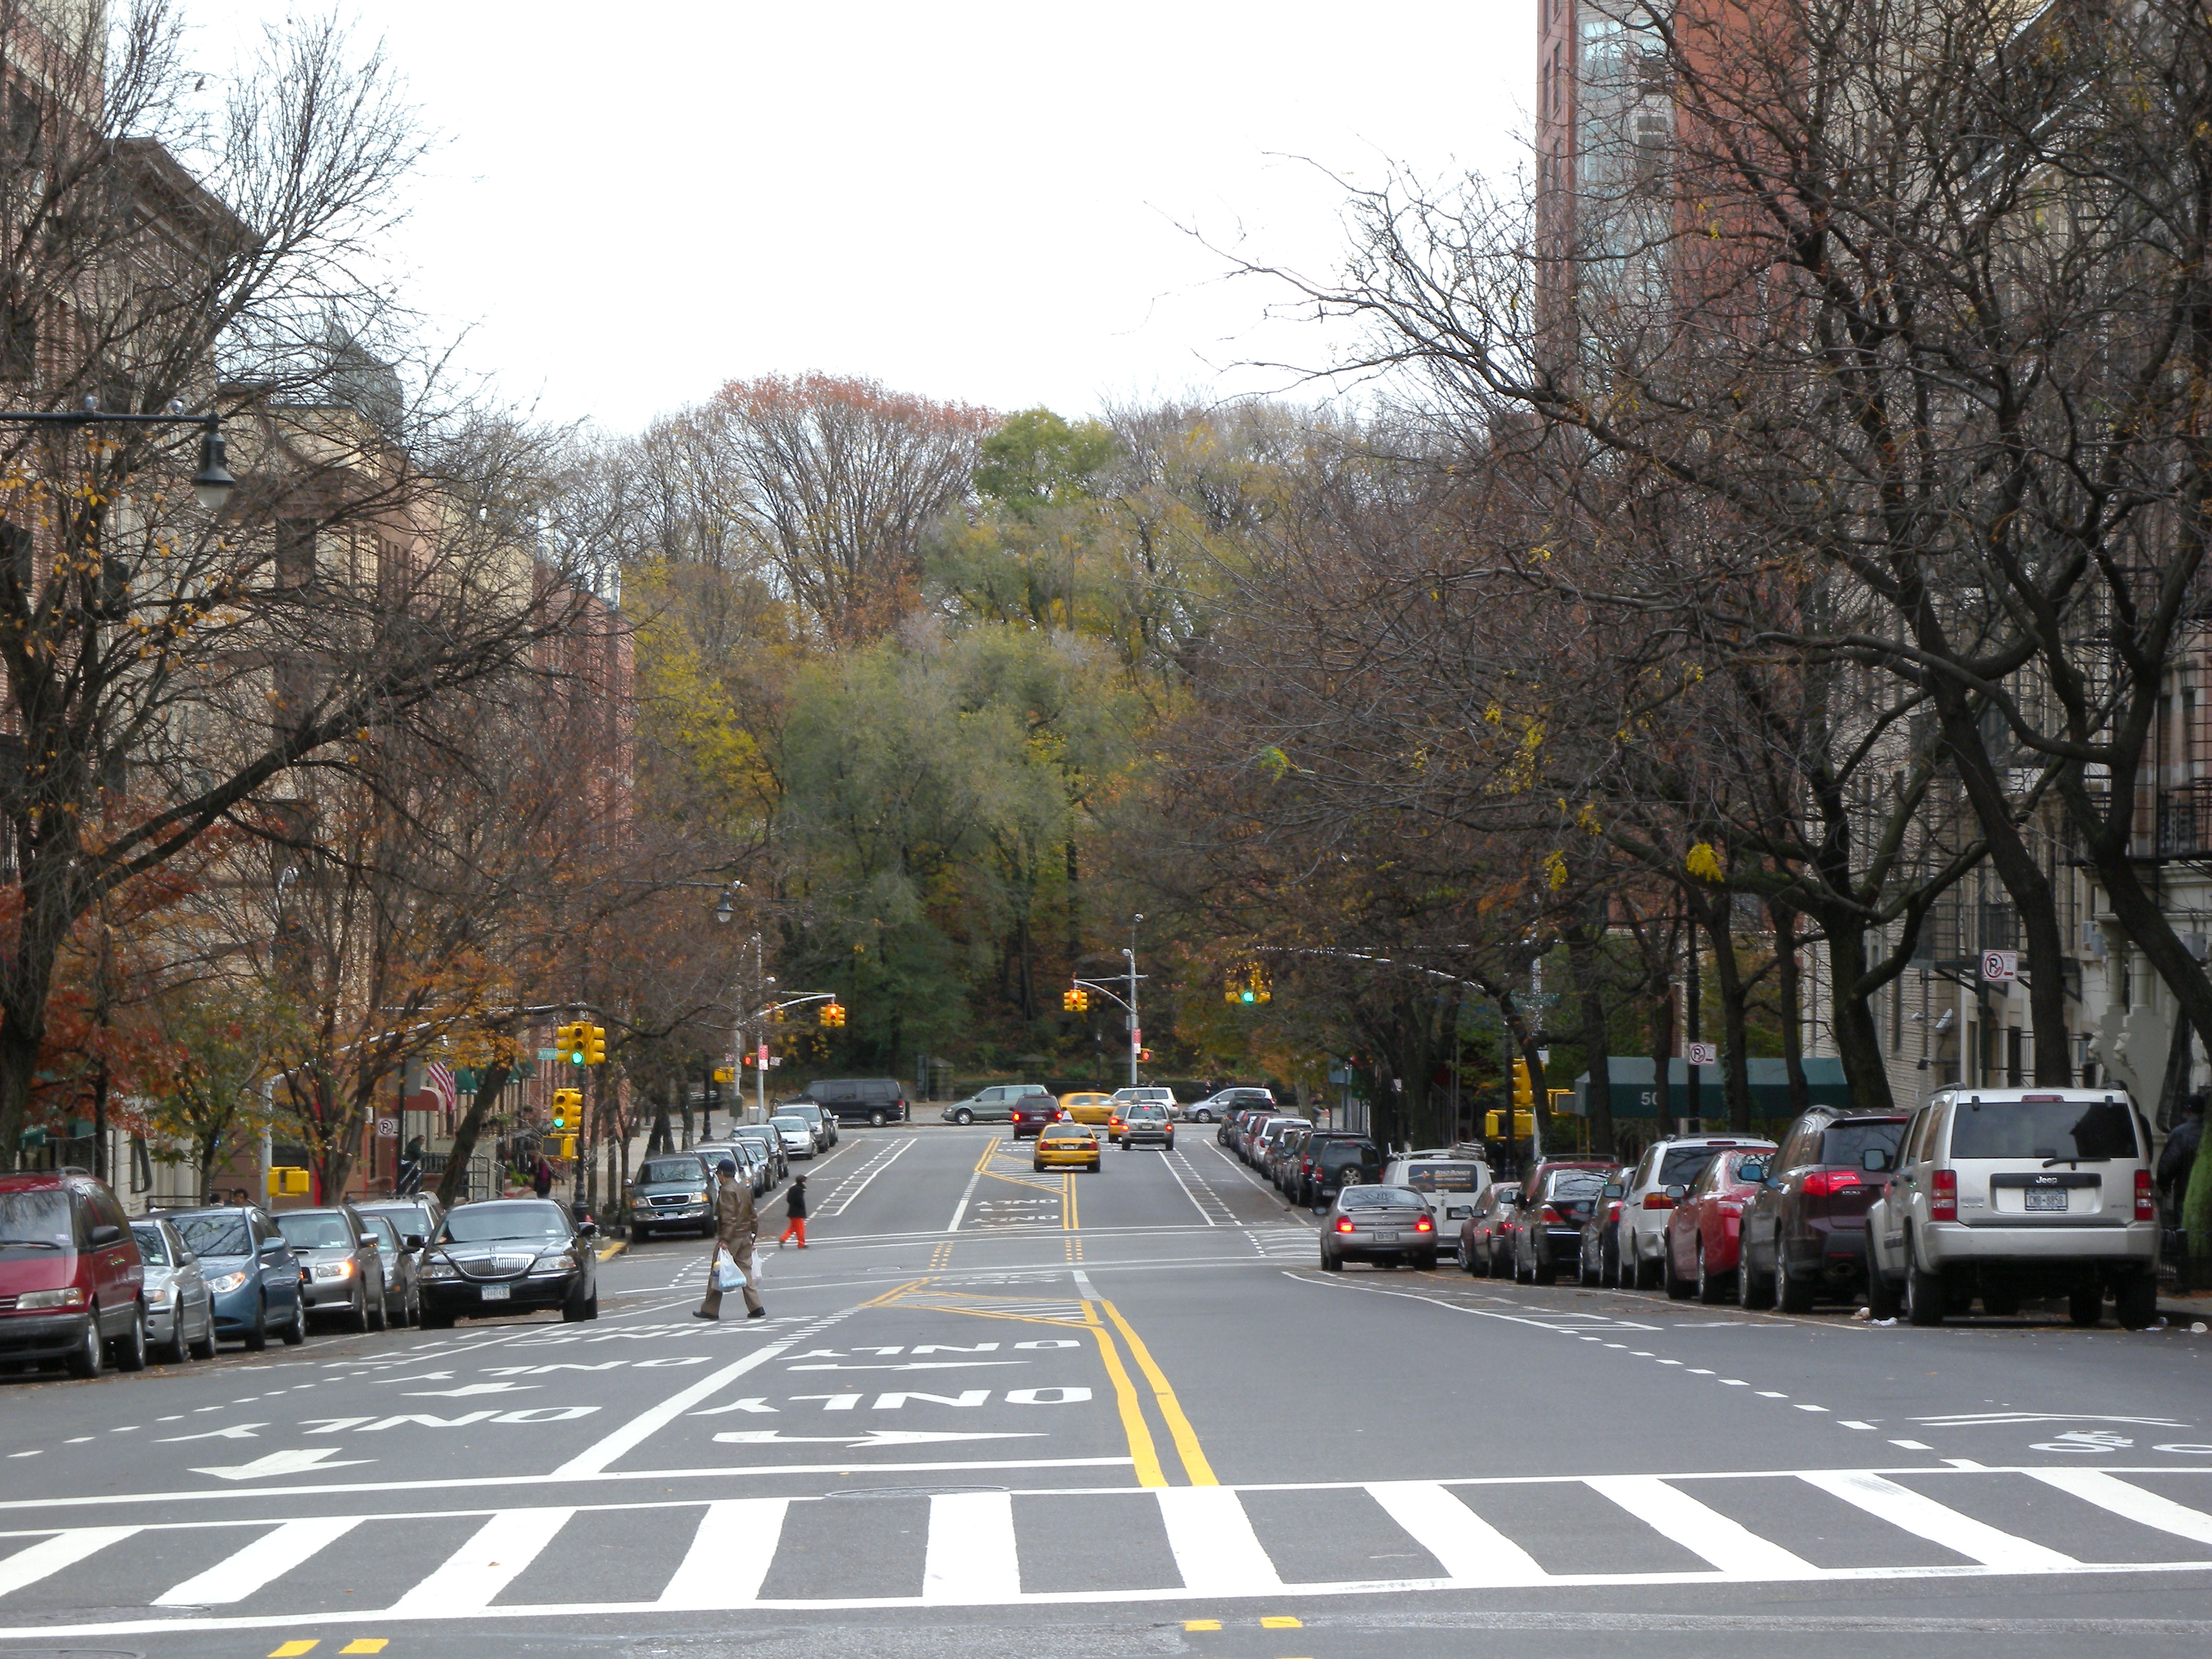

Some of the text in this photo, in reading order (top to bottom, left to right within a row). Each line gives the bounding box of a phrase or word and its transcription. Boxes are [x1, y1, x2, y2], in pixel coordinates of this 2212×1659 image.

[2036, 1176, 2057, 1184] Jeep
[777, 1340, 1081, 1361] ONLY
[370, 1356, 714, 1384] ONLY
[687, 1386, 1092, 1415] ONLY
[152, 1406, 602, 1442] ONLY
